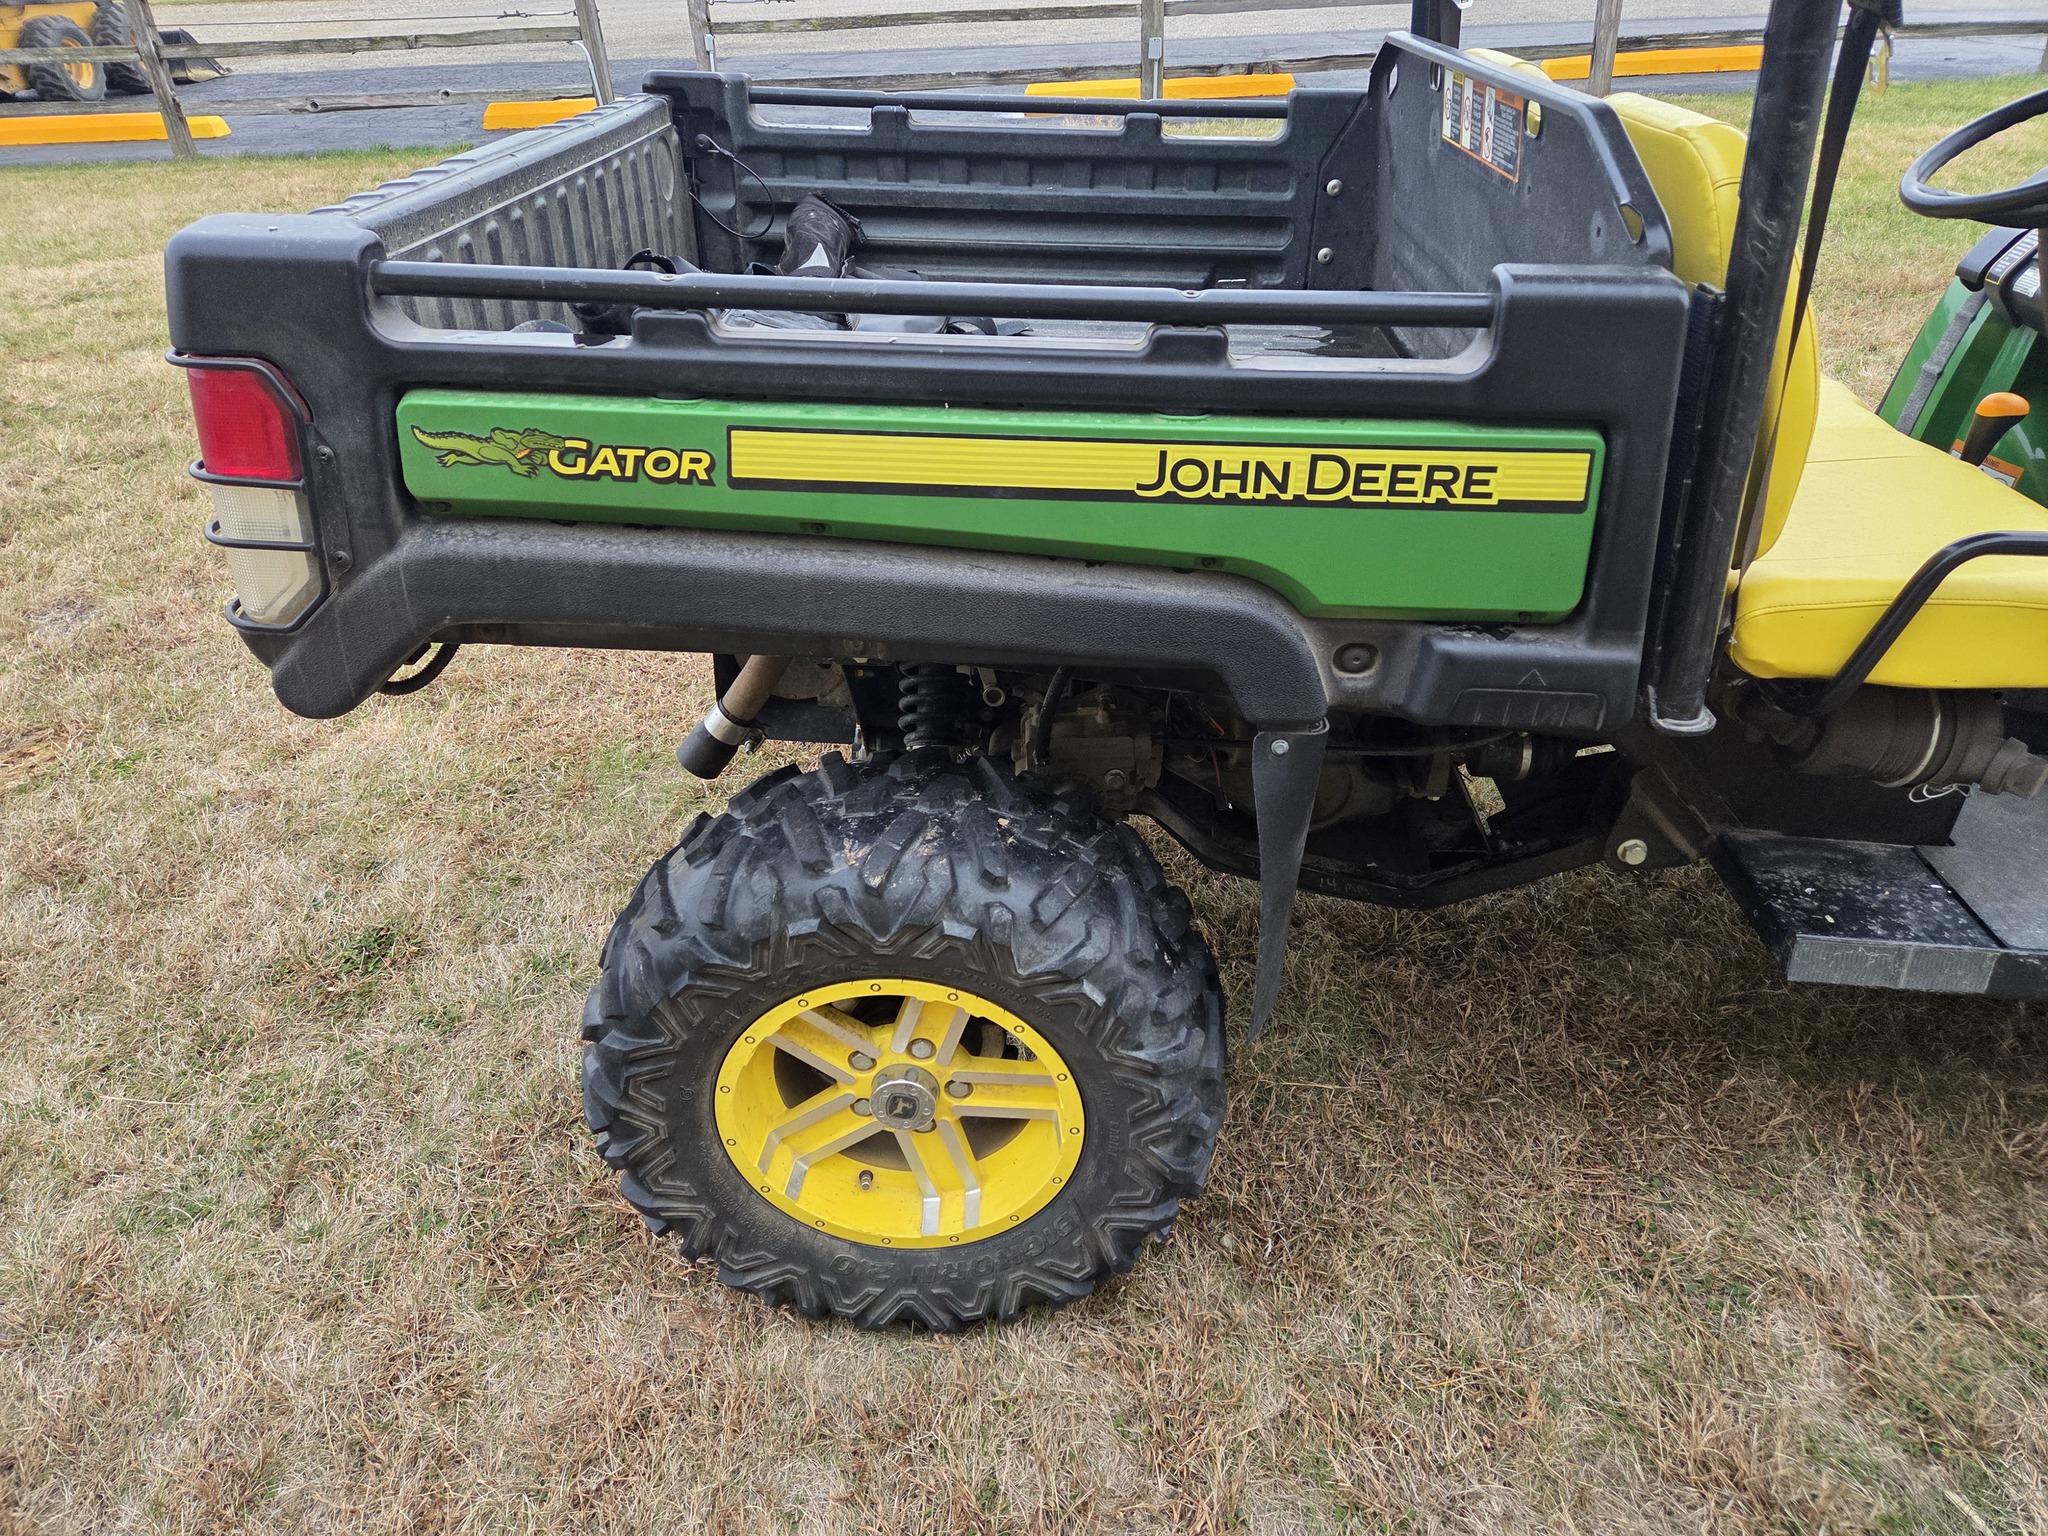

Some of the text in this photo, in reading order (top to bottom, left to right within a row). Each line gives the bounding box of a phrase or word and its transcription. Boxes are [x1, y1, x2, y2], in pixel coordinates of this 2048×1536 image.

[547, 439, 714, 484] GATOR
[1135, 449, 1500, 502] JOHN DEERE
[910, 1210, 1079, 1284] BIGHORN
